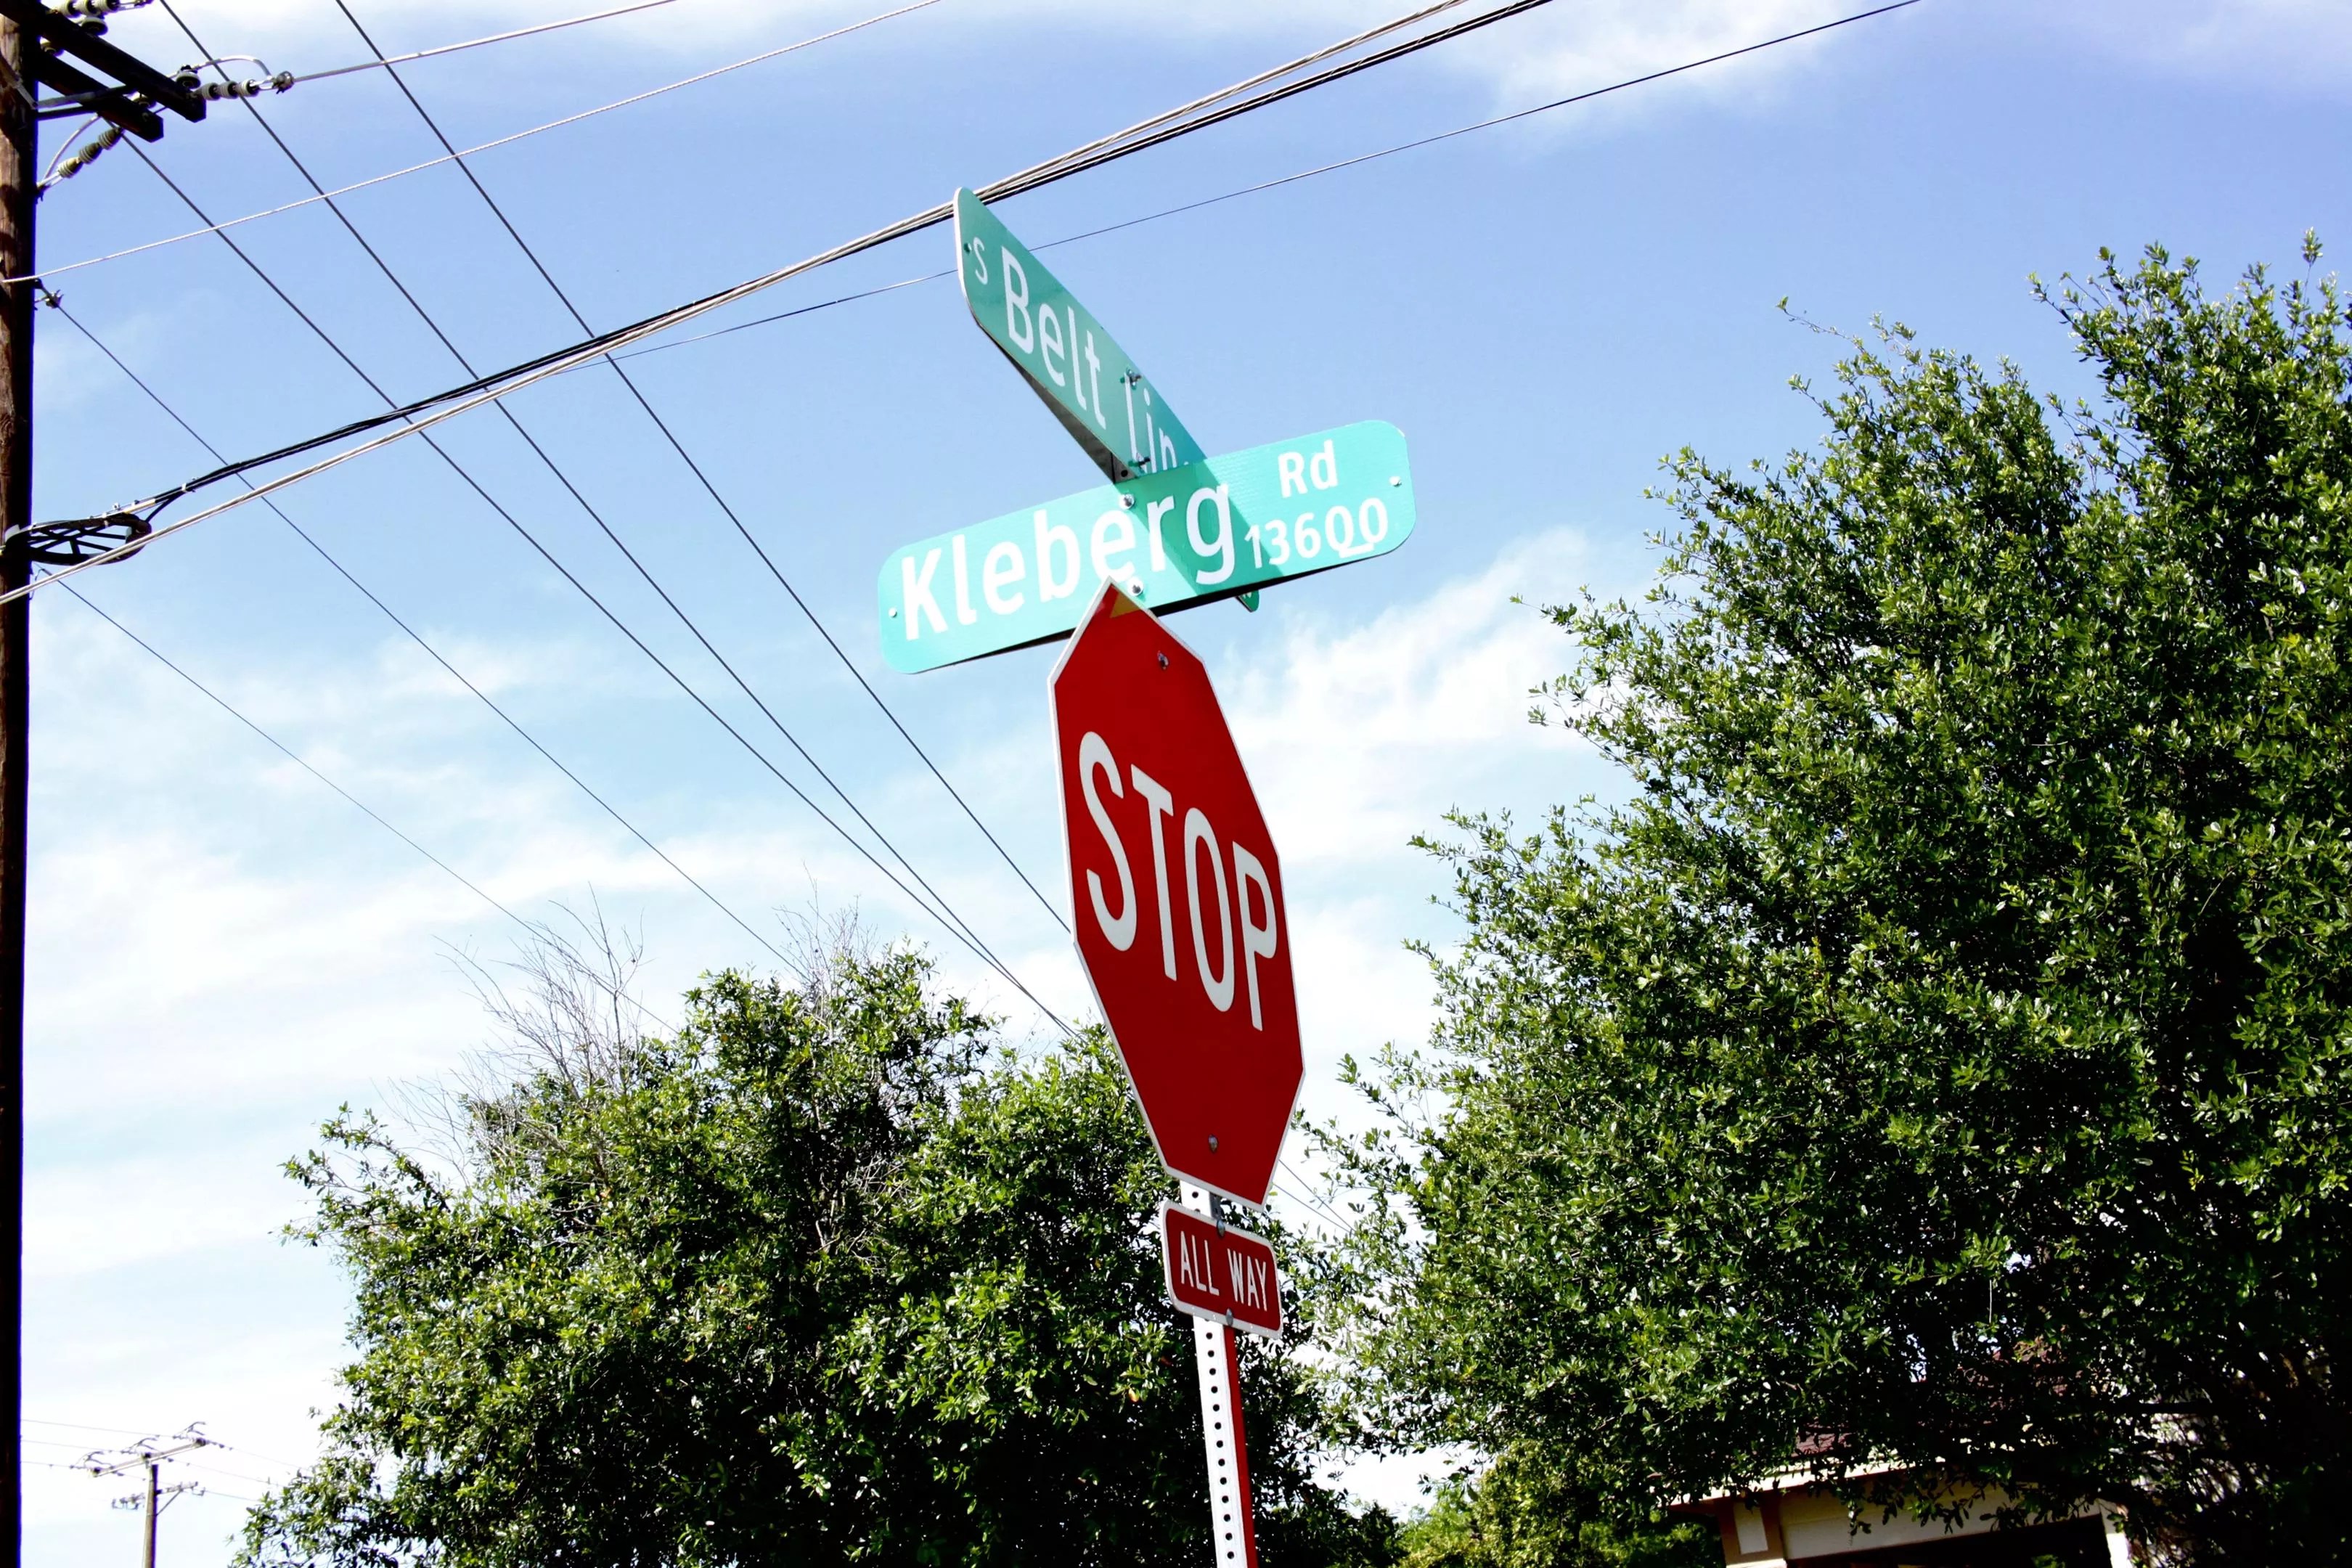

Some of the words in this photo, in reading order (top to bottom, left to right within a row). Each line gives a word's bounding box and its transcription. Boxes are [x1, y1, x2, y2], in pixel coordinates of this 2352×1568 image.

[973, 237, 988, 285] S
[1002, 245, 1107, 430] Belt
[1124, 372, 1189, 475] Lin
[900, 482, 1236, 641] Kleberg
[1278, 439, 1339, 498] Rd
[1244, 497, 1389, 568] 13600
[1079, 731, 1278, 1032] STOP
[1180, 1230, 1220, 1297] ALL
[1227, 1248, 1267, 1312] WAY
